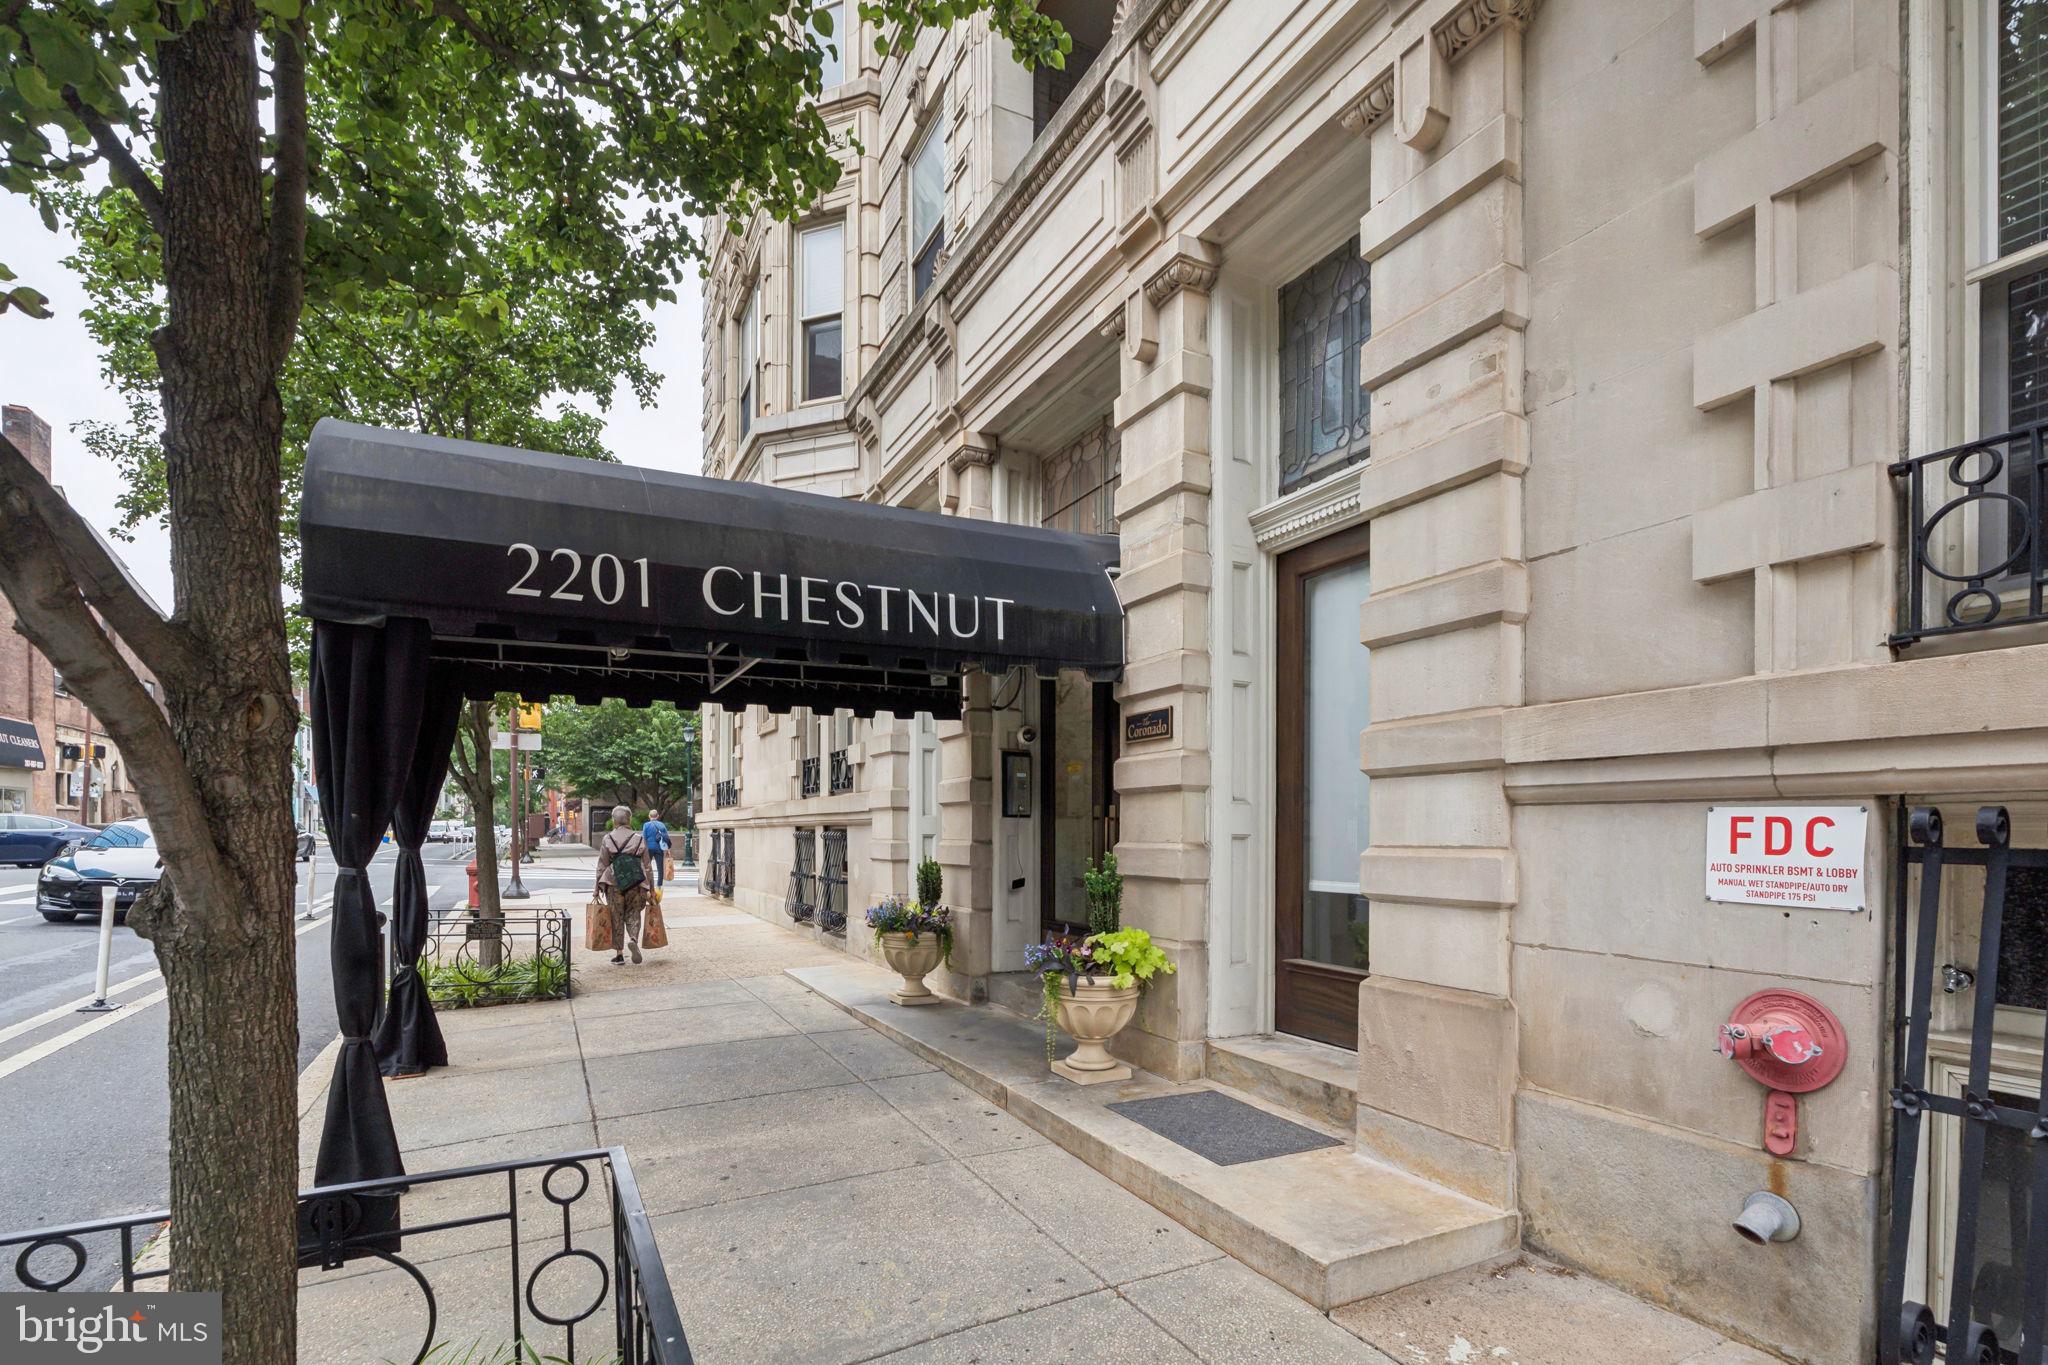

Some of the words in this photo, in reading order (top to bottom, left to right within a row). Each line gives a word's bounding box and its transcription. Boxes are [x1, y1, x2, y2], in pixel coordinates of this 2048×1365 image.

[506, 542, 650, 609] 2201
[702, 565, 1015, 641] CHESTNUT
[1127, 718, 1168, 740] Coronado
[9, 734, 40, 749] CLEANERS
[1729, 815, 1836, 858] FDC
[1710, 862, 1733, 873] AUTO
[1734, 863, 1785, 876] SPRINKLER
[1787, 866, 1814, 877] BSMT
[1816, 867, 1823, 877] &
[1826, 867, 1858, 879] LOBBY
[1717, 878, 1747, 887] MANUAL
[1748, 879, 1764, 888] WET
[1765, 880, 1831, 892] STANDPIPE/AUTO
[1832, 884, 1848, 893] DRY
[1745, 889, 1786, 900] STANDPIPE
[1788, 892, 1801, 901] 175
[1802, 893, 1816, 902] PSI
